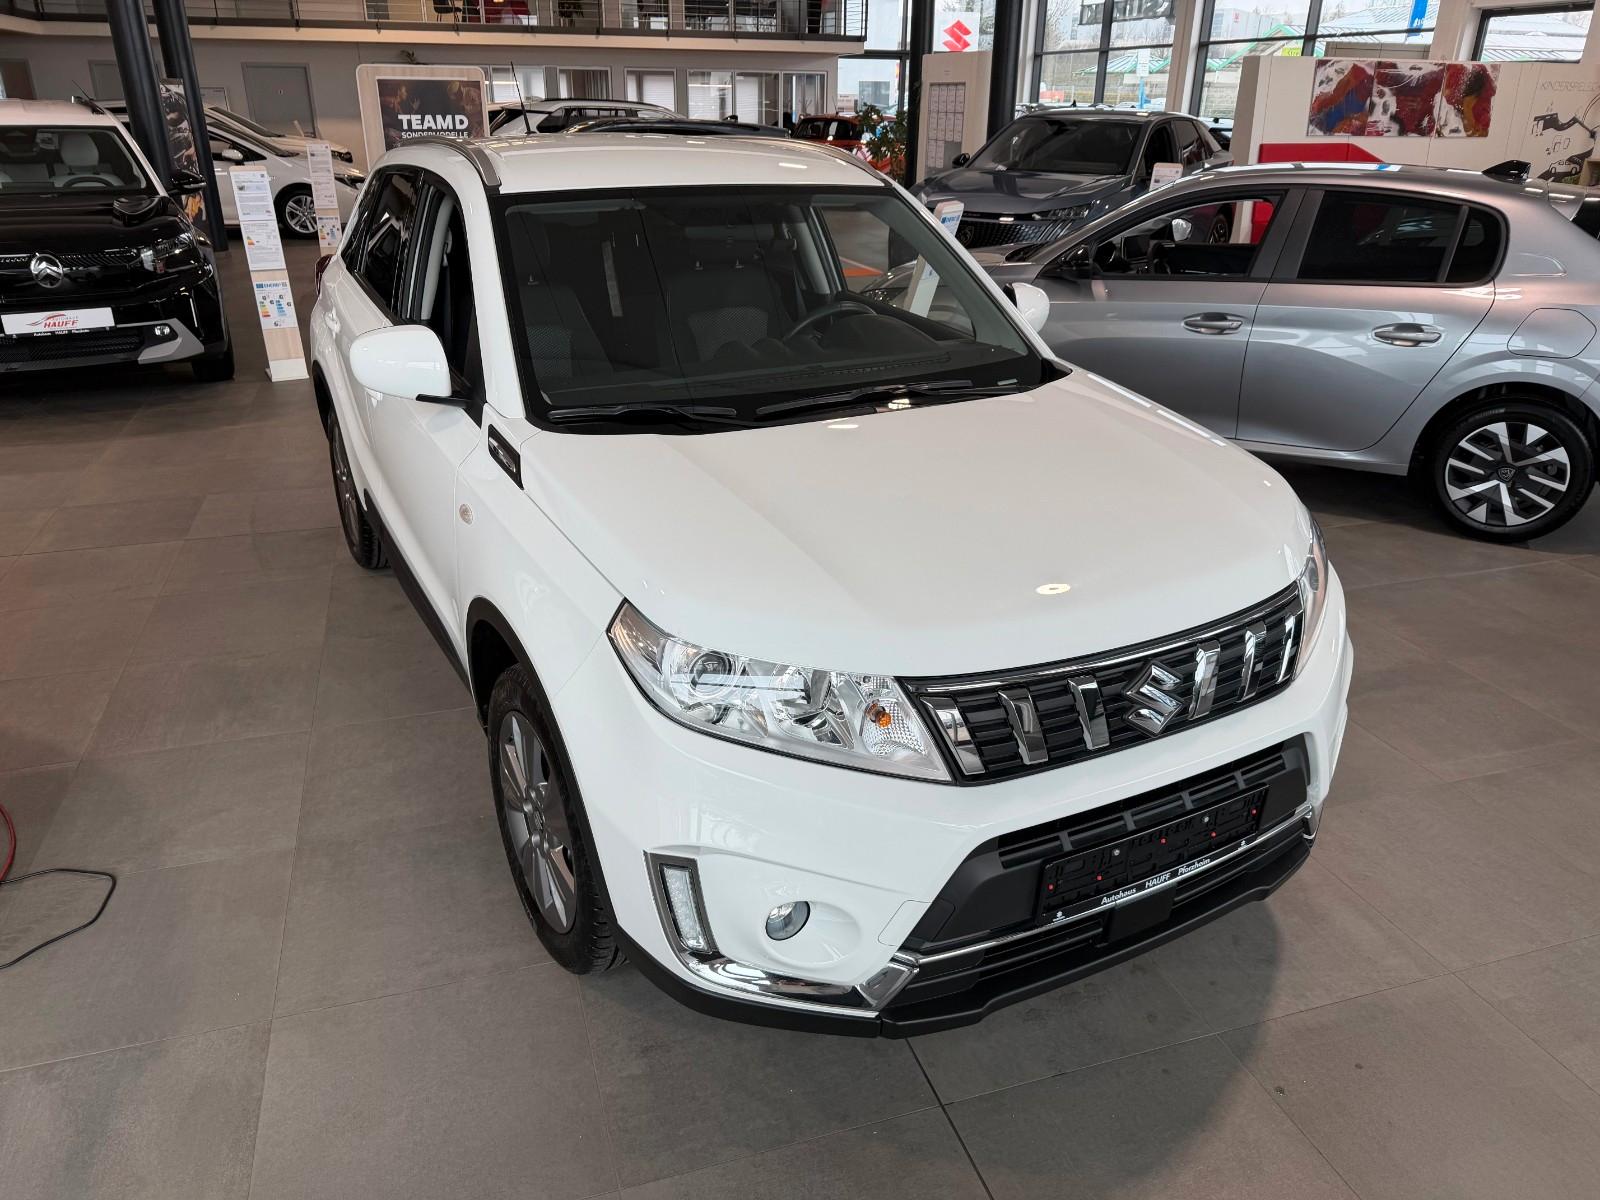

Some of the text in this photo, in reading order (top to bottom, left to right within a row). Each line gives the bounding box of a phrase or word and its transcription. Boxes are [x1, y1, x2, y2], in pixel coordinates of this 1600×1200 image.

[44, 320, 79, 328] HAUFF
[1101, 858, 1211, 904] Autohaus HAUFF Pforzheim
